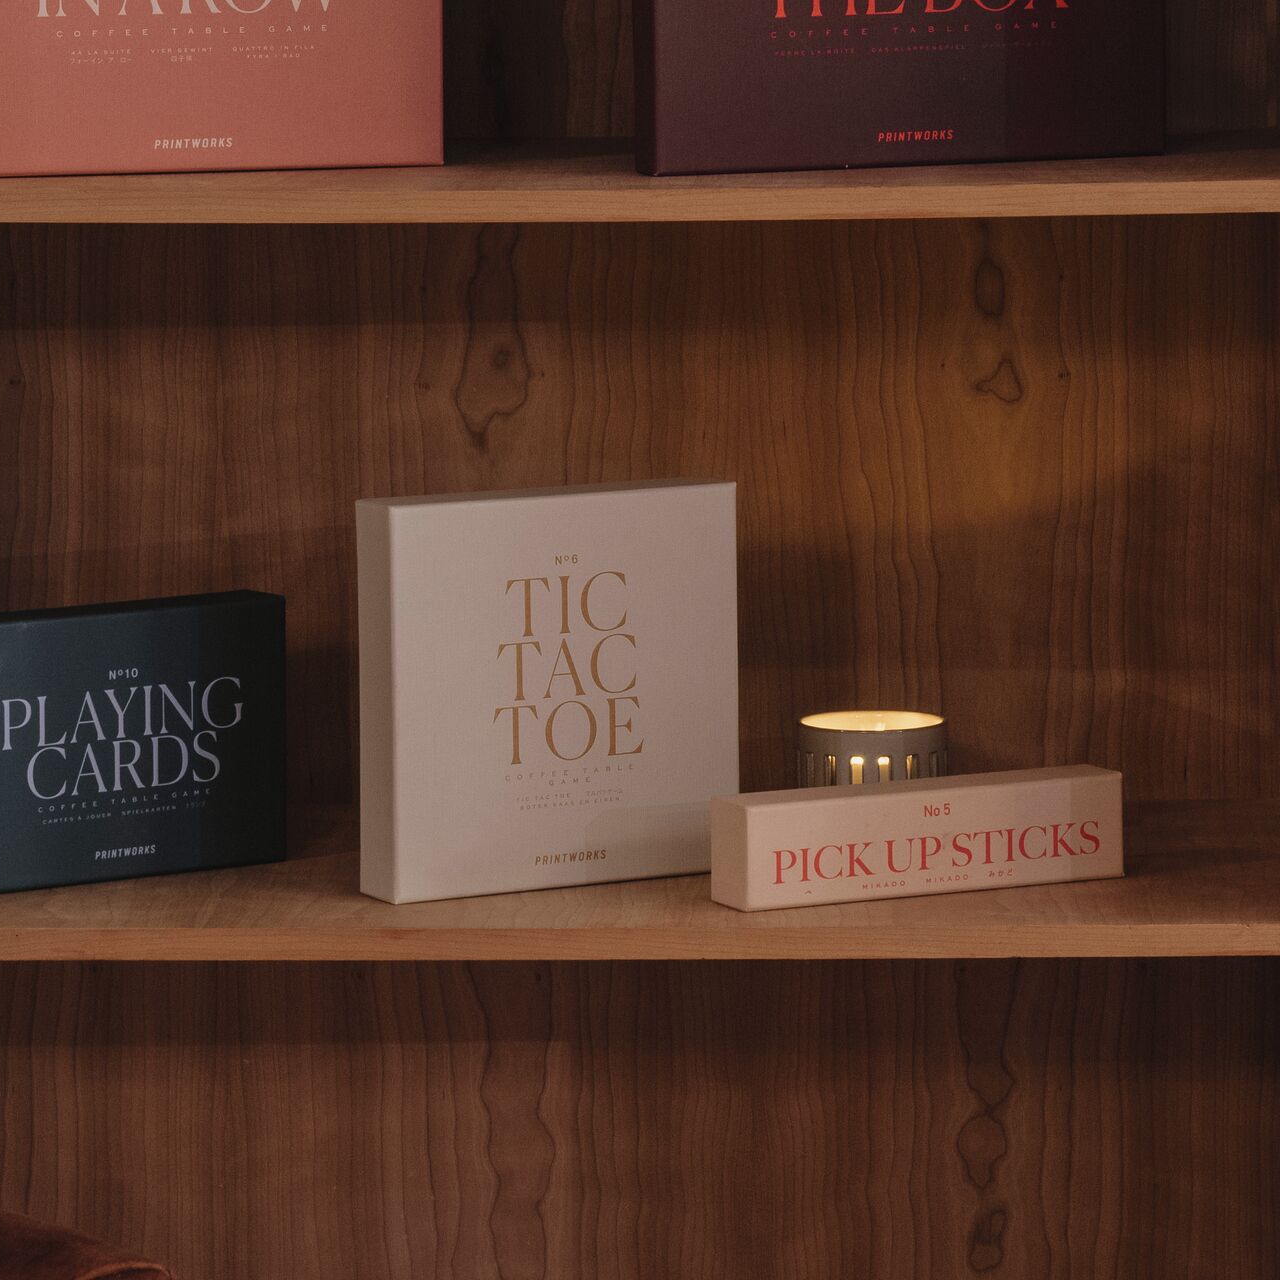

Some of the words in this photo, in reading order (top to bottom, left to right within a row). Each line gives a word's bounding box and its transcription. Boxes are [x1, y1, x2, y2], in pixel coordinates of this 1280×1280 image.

[55, 28, 149, 39] COFFEE
[171, 26, 248, 36] TABLE
[267, 24, 329, 34] GAME
[770, 27, 869, 39] COFFEE
[891, 24, 971, 34] TABLE
[994, 21, 1057, 31] GAME
[154, 137, 233, 149] PRINTWORKS
[878, 129, 953, 142] PRINTWORKS
[504, 570, 628, 637] TIC
[496, 633, 638, 701] TAC
[1, 676, 244, 751] PLAYING
[492, 695, 645, 765] TOE
[26, 730, 221, 800] CARDS
[504, 768, 570, 782] COFFEE
[582, 763, 635, 774] TABLE
[548, 776, 592, 787] GAME
[37, 801, 98, 813] COFFEE
[111, 793, 159, 805] TABLE
[171, 788, 211, 799] GAME
[95, 844, 156, 860] PRINTWORKS
[535, 849, 607, 865] PRINTWORKS
[772, 841, 876, 885] PICK
[884, 835, 942, 873] UP
[951, 819, 1101, 867] STICKS
[862, 879, 906, 890] MIKADO
[925, 873, 969, 884] MIKADO
